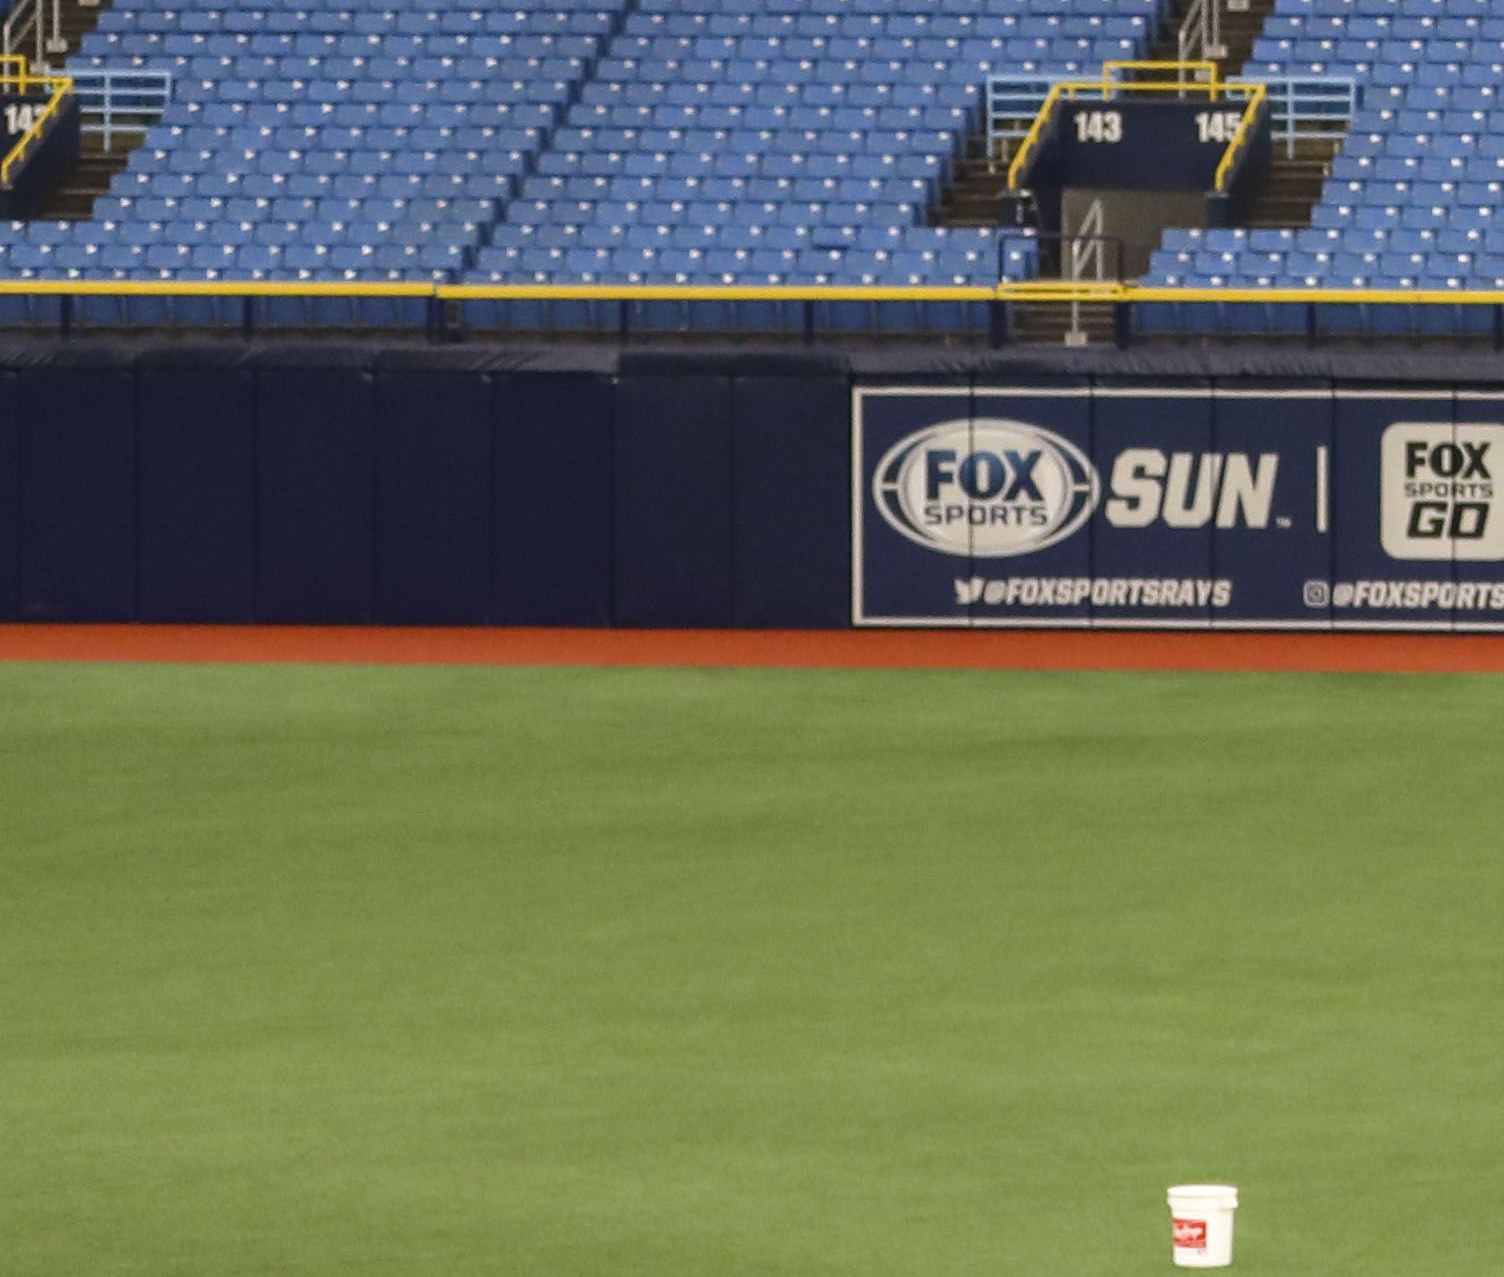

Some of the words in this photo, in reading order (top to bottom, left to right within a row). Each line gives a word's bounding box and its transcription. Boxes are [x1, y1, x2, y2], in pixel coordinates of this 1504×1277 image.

[4, 104, 47, 135] 14
[1076, 113, 1121, 142] 143
[1197, 114, 1242, 142] 145
[925, 450, 1043, 501] FOX
[1405, 441, 1492, 481] FOX
[1105, 449, 1279, 529] SUN
[1404, 482, 1494, 500] SPORTS
[923, 504, 1050, 527] SPORTS
[1406, 501, 1491, 540] GO
[984, 578, 1232, 608] @FOXSPORTSRAYS
